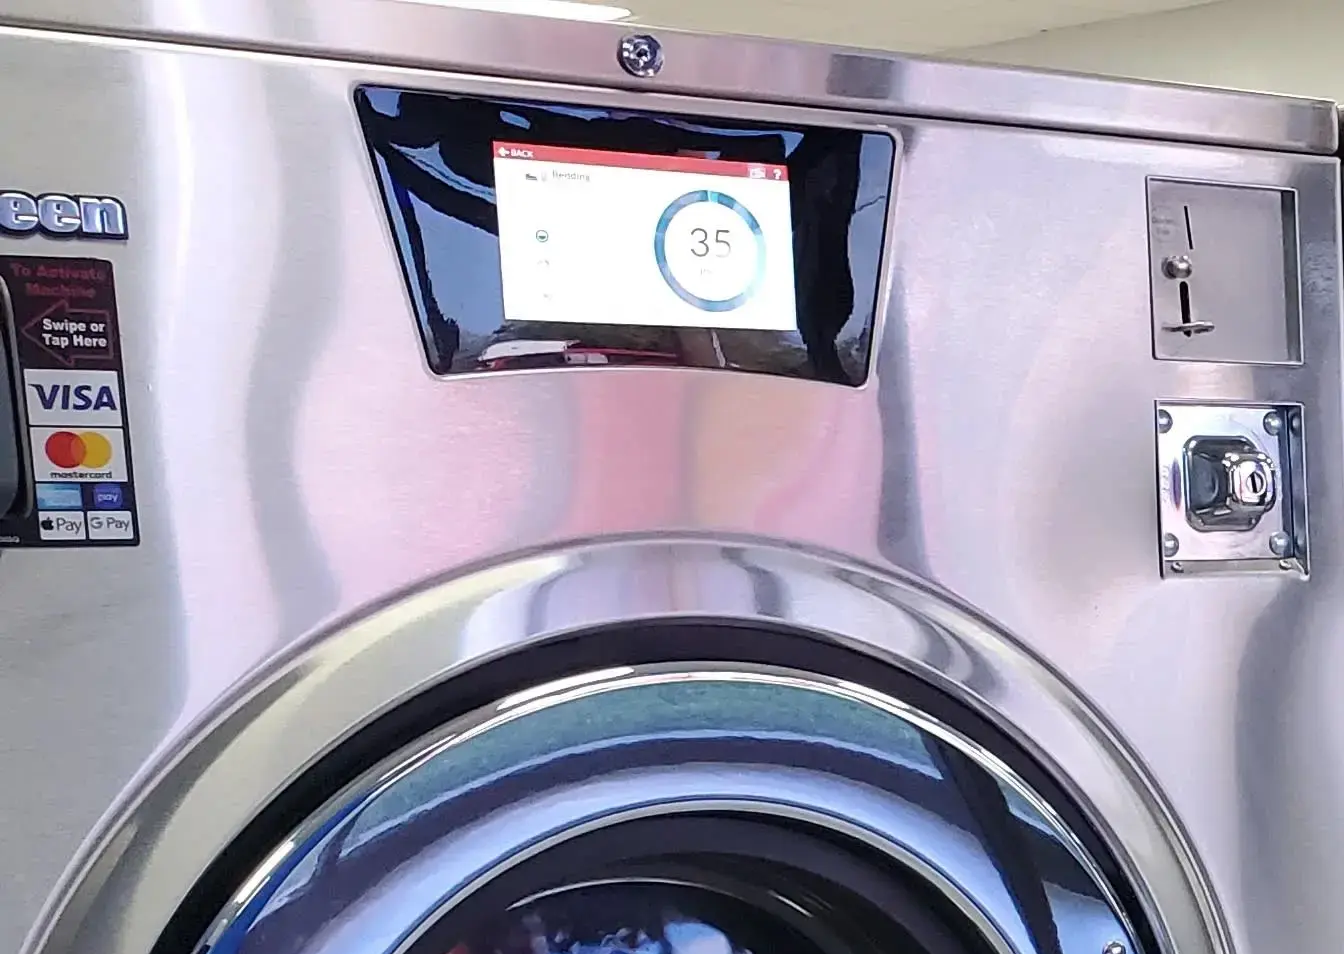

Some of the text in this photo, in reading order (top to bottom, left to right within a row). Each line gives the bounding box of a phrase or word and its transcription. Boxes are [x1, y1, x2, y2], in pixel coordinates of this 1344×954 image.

[511, 148, 534, 158] BACK
[690, 228, 732, 258] 35
[11, 263, 106, 280] To Activate
[26, 282, 96, 298] Machine
[42, 318, 106, 334] Swipe or
[42, 333, 107, 349] Tap Here
[28, 383, 117, 411] VISA
[50, 471, 112, 479] mastercard
[56, 517, 82, 535] Pay
[106, 517, 130, 532] Pay
